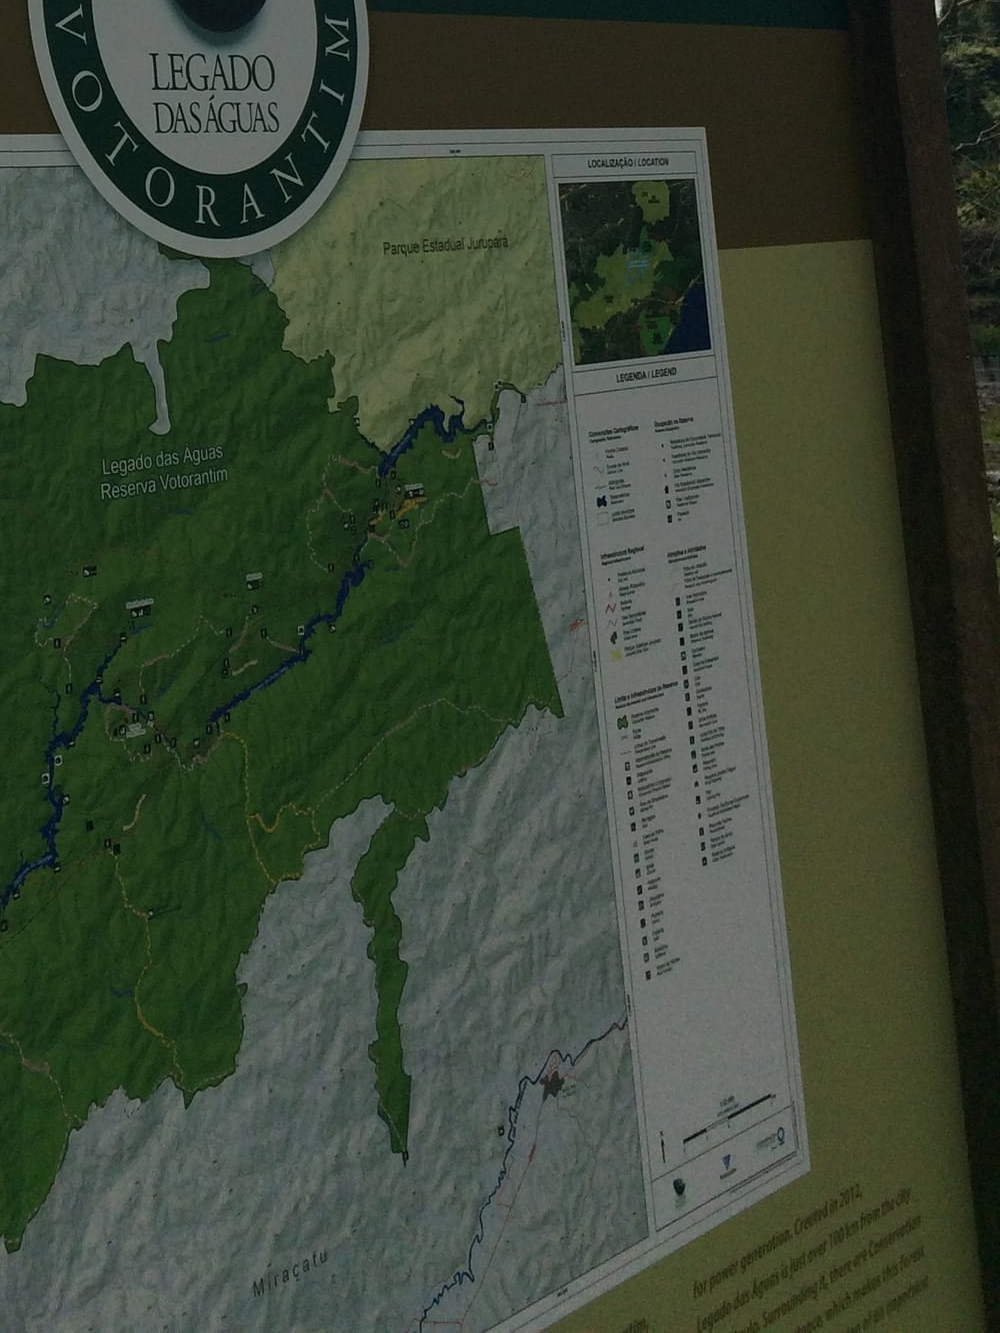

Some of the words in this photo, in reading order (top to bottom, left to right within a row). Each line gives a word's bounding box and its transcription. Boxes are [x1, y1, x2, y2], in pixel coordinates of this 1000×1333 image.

[149, 52, 276, 92] LEGADO
[55, 3, 351, 227] VOTORANTIM
[638, 157, 669, 167] LOCATION
[383, 241, 420, 257] Parque
[422, 238, 465, 253] Estadual
[616, 370, 647, 383] LEGENDA
[651, 366, 677, 379] LEGEND
[102, 455, 152, 477] Legado
[155, 450, 180, 467] das
[183, 443, 224, 466] Águas
[100, 480, 157, 500] Reserva
[159, 467, 229, 491] Votorantim
[693, 1279, 708, 1299] for
[794, 1201, 829, 1236] Created
[829, 1198, 839, 1215] in
[252, 1249, 329, 1298] Miracatu
